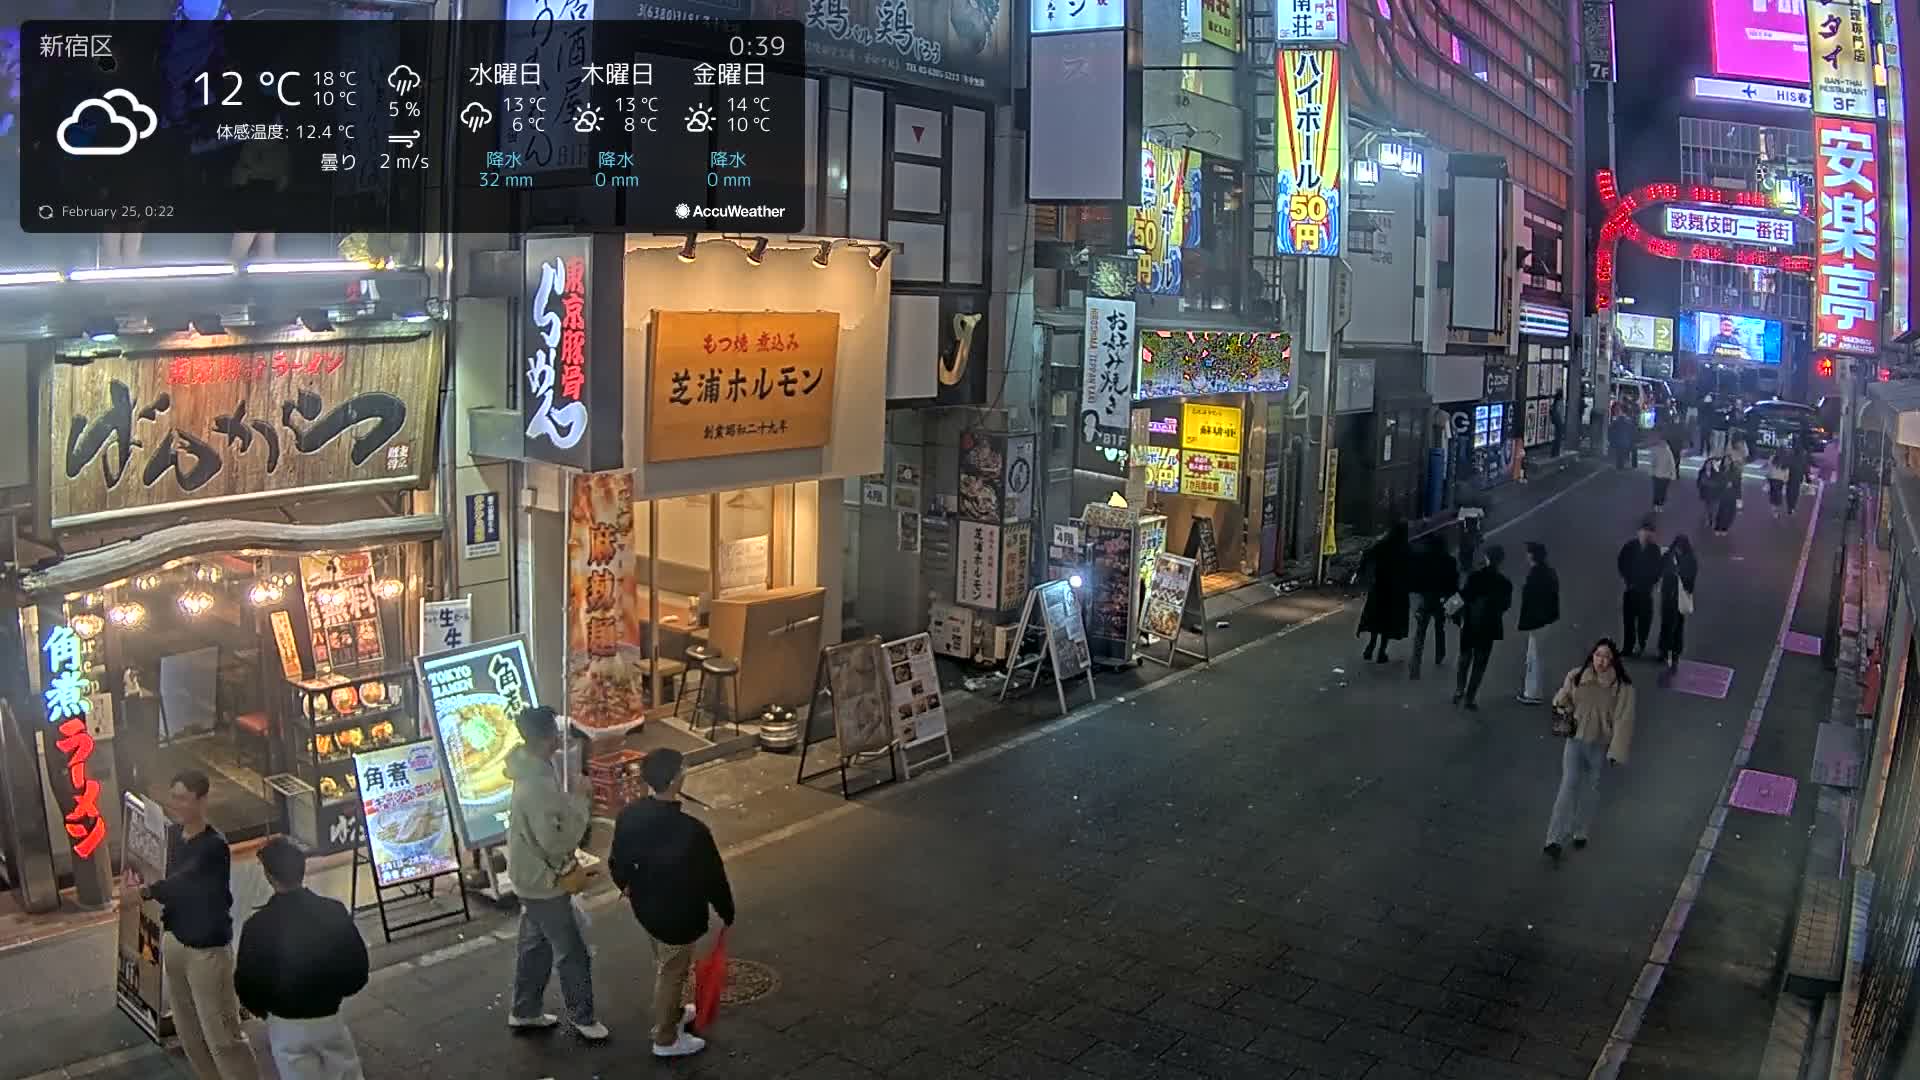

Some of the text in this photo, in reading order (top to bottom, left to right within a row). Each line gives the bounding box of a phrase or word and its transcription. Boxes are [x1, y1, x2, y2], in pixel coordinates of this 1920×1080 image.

[1294, 53, 1322, 191] ハイボール
[1832, 97, 1857, 111] 3F
[1161, 149, 1177, 289] ハイボール
[1671, 210, 1791, 243] 歌舞伎町一番街
[1819, 127, 1876, 331] 安楽亭
[561, 256, 585, 401] 東京豚骨
[703, 332, 800, 354] もつ焼 煮込み
[1819, 332, 1837, 348] 2F
[1100, 309, 1129, 415] お好み焼き
[668, 366, 825, 407] 芝浦ホルモン
[427, 664, 473, 685] TOKYO
[363, 761, 410, 791] 角煮
